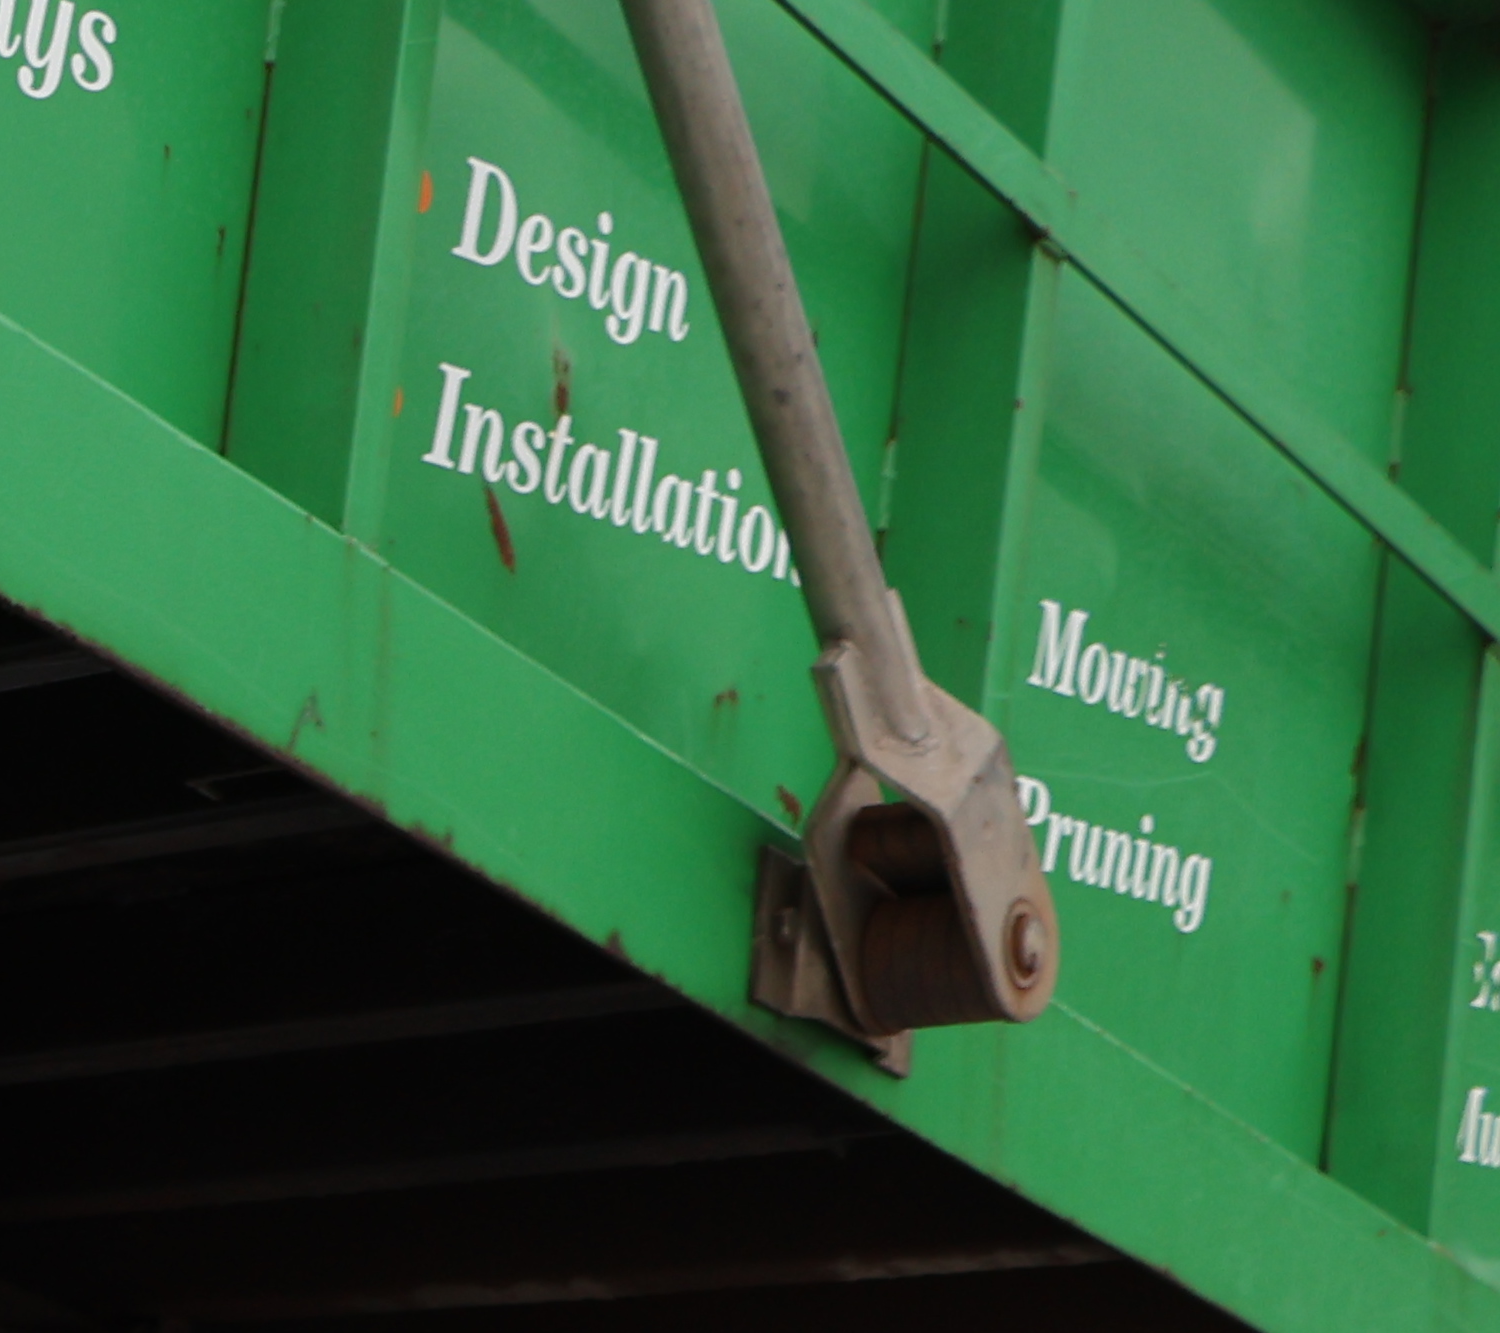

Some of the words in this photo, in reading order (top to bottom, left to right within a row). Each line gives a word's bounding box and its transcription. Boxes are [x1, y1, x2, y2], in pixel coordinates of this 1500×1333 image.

[451, 157, 690, 345] Design
[1026, 599, 1224, 763] Mowing
[1015, 775, 1213, 934] Pruning
